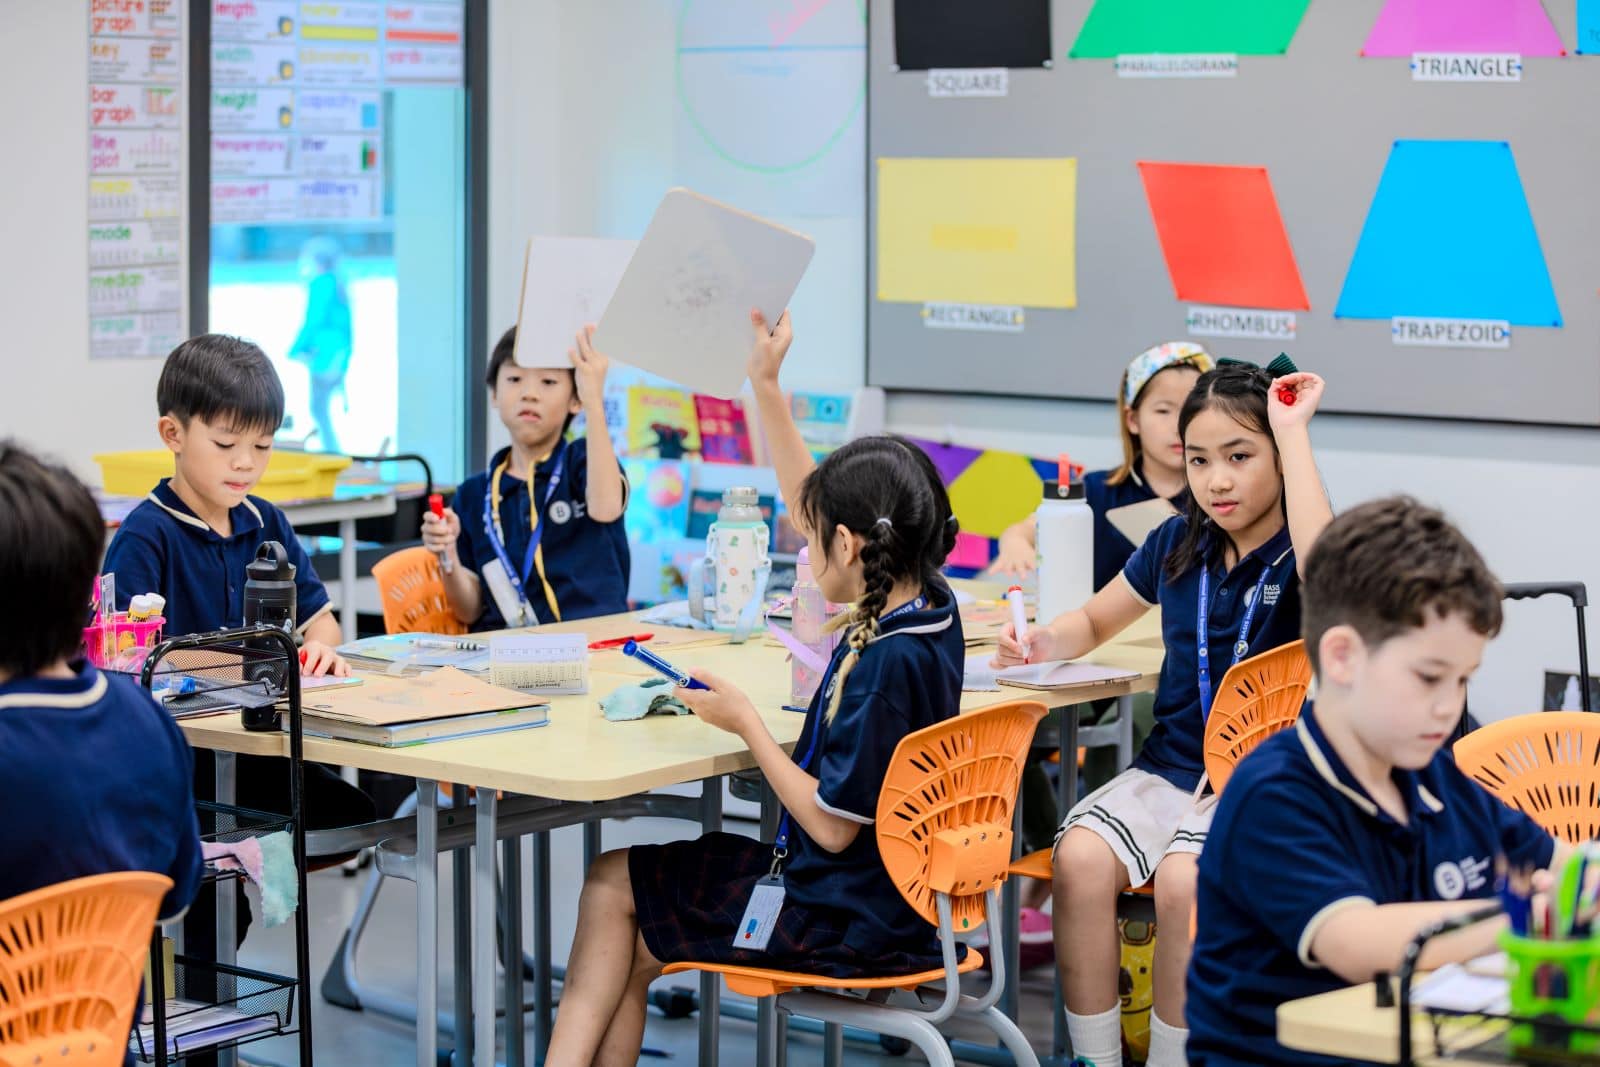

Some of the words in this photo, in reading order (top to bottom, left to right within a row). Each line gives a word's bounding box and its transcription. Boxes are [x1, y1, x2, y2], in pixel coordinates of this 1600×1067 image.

[91, 16, 136, 33] graph
[91, 42, 119, 61] key
[1418, 57, 1517, 77] TRIANGLE
[934, 74, 1002, 92] SQUARE
[91, 86, 118, 103] bar
[91, 105, 136, 125] graph
[91, 134, 116, 150] line
[91, 153, 120, 172] plot
[90, 224, 131, 241] mode
[90, 272, 145, 288] median
[930, 305, 1021, 326] RECTANGLE
[1193, 312, 1291, 334] RHOMBUS
[1398, 321, 1507, 343] TRAPEZOID
